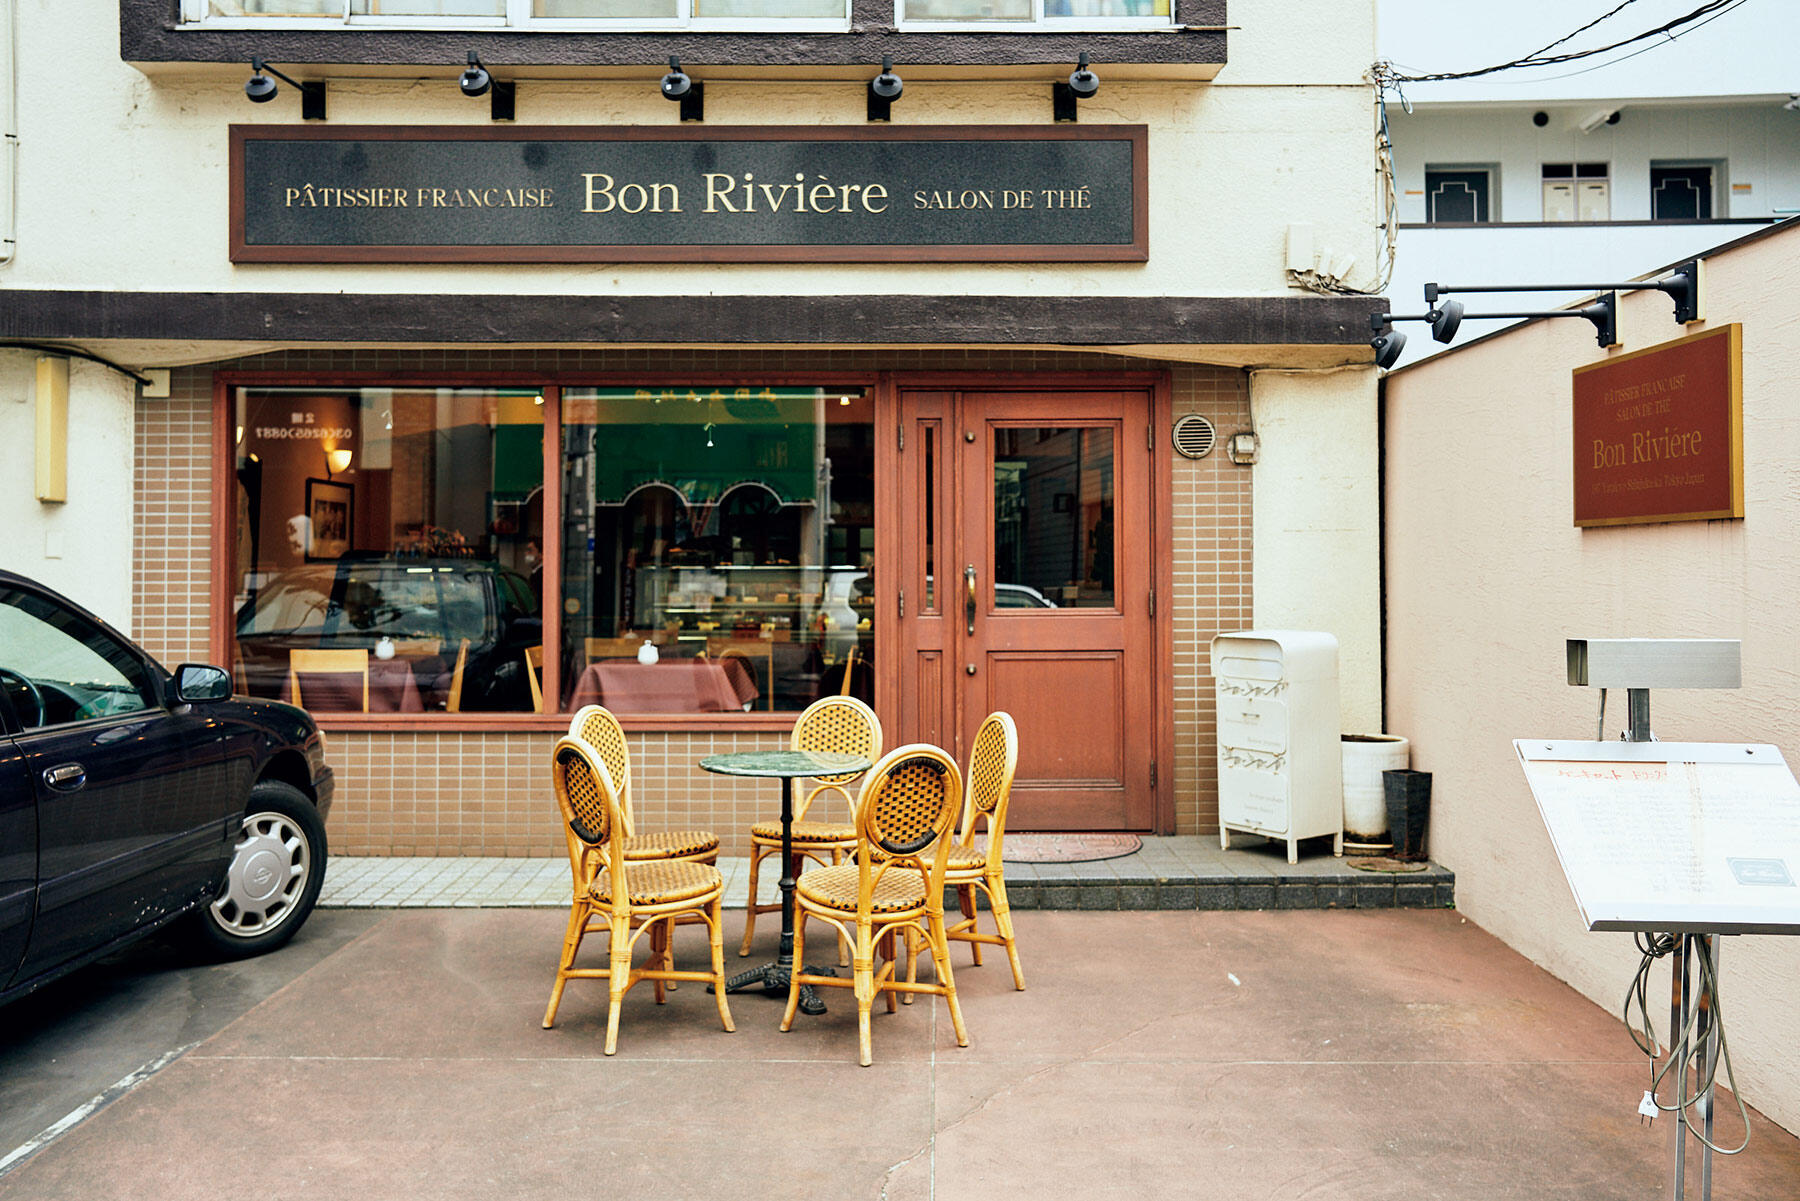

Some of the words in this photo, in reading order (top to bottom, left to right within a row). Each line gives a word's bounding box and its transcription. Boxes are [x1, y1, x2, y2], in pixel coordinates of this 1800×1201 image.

[285, 182, 408, 208] PÂTISSIER
[417, 187, 554, 208] FRANCAISE
[581, 172, 683, 215] Bon
[702, 172, 889, 214] Rivière
[913, 189, 994, 210] SALON
[1002, 189, 1034, 210] DE
[1041, 184, 1091, 210] THÉ
[1592, 438, 1627, 470] Bon
